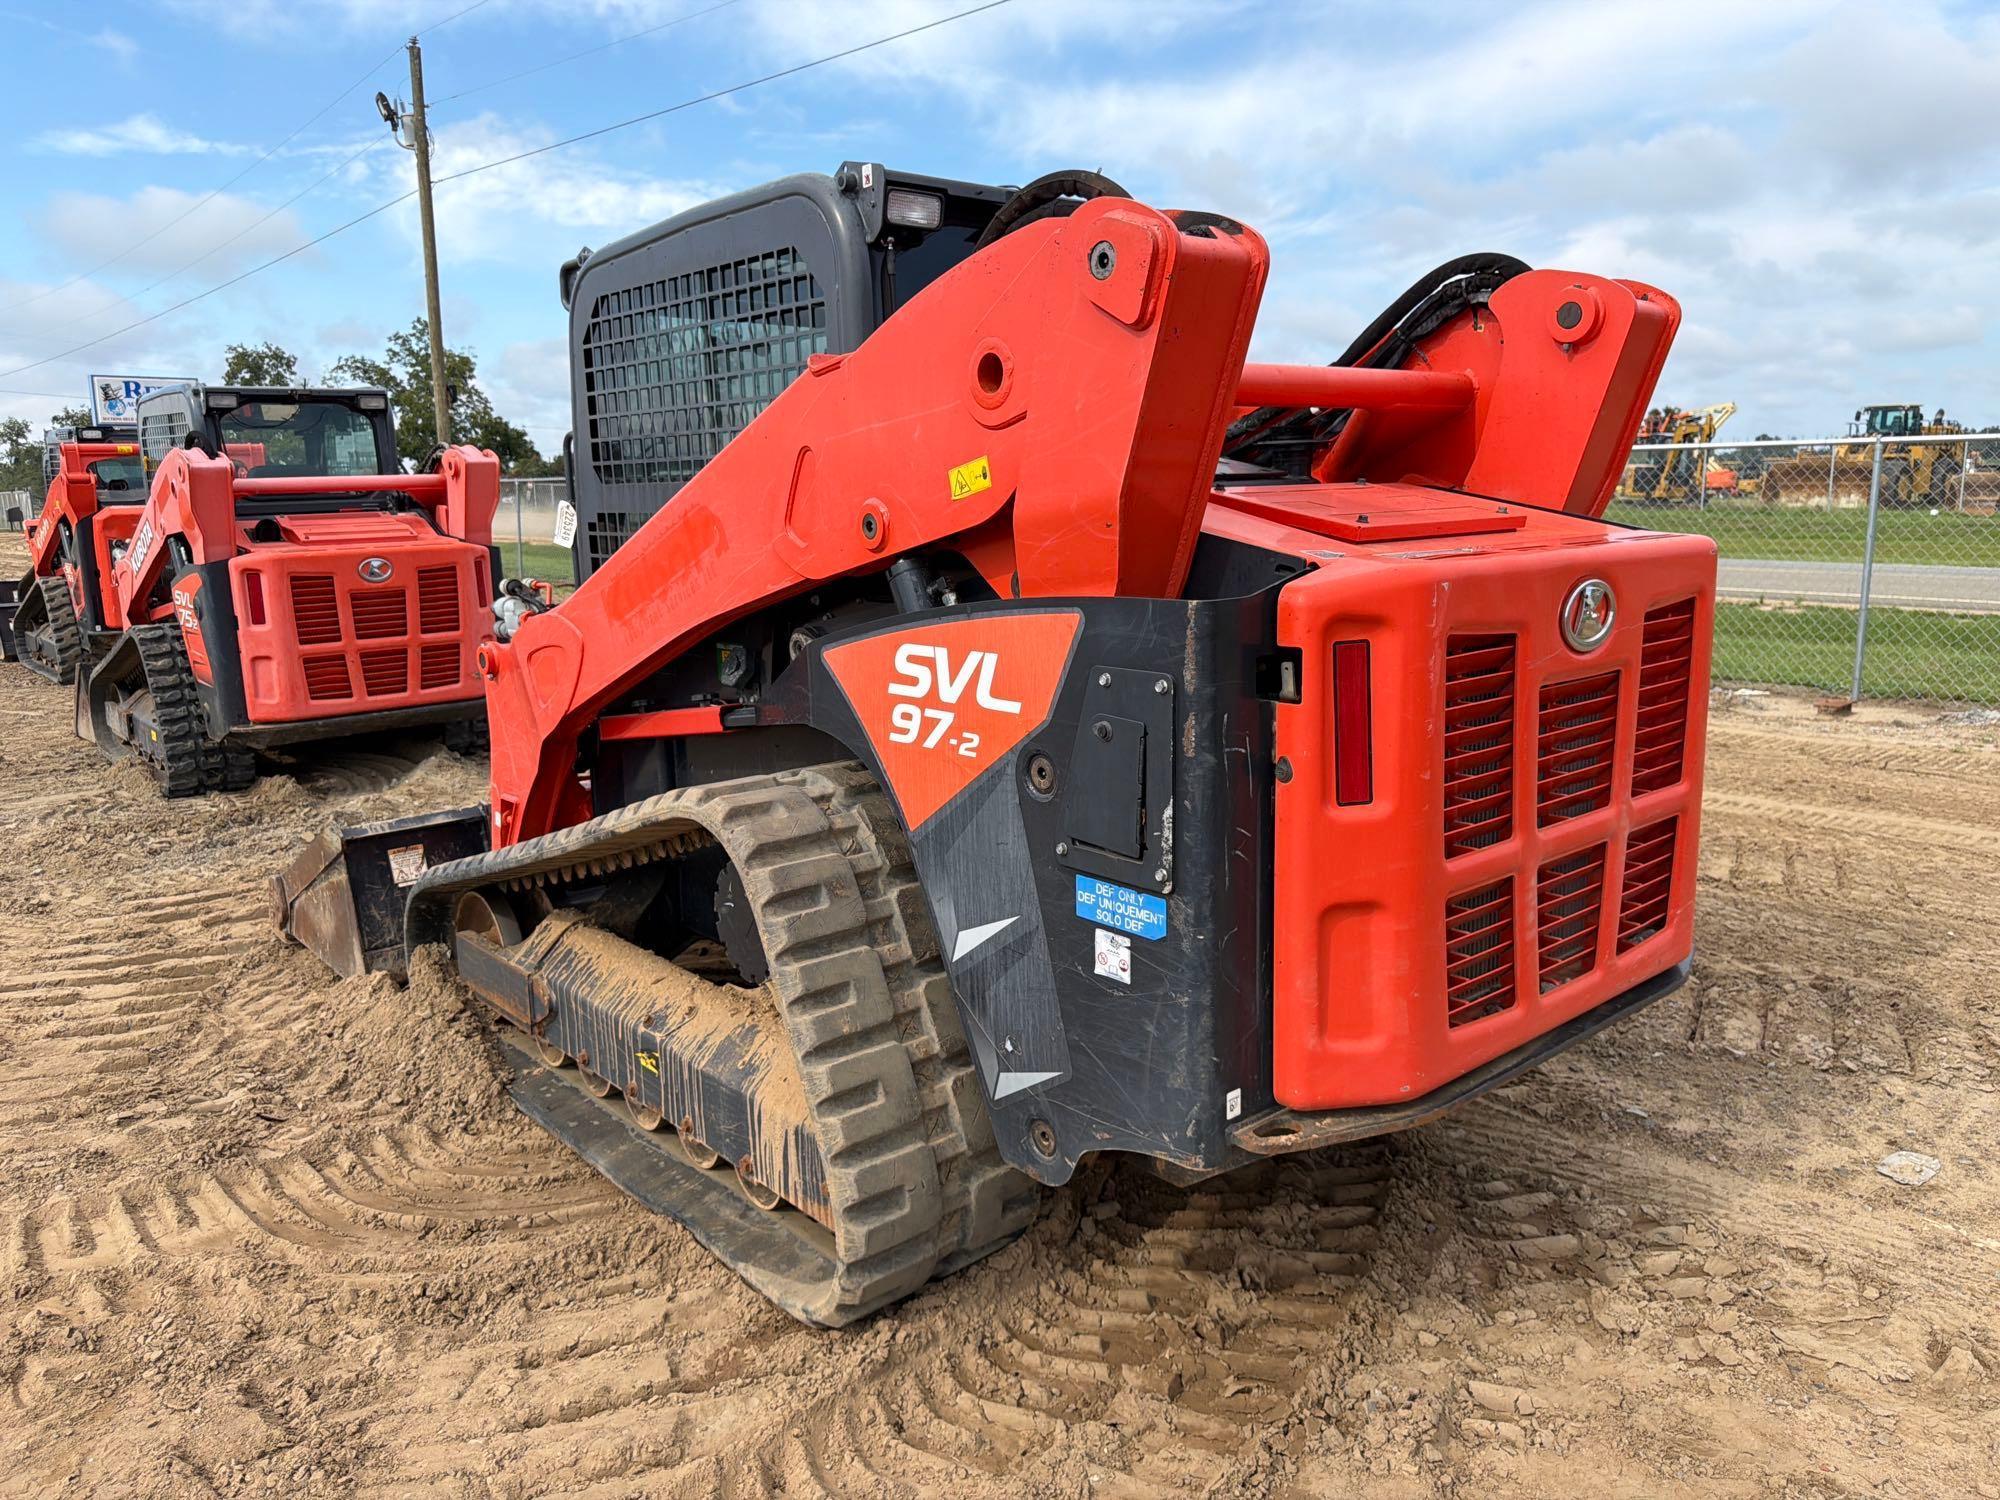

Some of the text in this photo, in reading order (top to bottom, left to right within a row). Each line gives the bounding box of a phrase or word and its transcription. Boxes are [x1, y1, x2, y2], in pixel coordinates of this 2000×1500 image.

[130, 521, 153, 573] KUBOTA
[174, 589, 194, 609] SVL
[887, 643, 1022, 715] SVL
[888, 703, 981, 758] 97-2
[1077, 891, 1164, 926] DEF UNIQUEMENT
[1095, 882, 1144, 906] DEF ONLY
[1096, 909, 1144, 932] SOLO DEF
